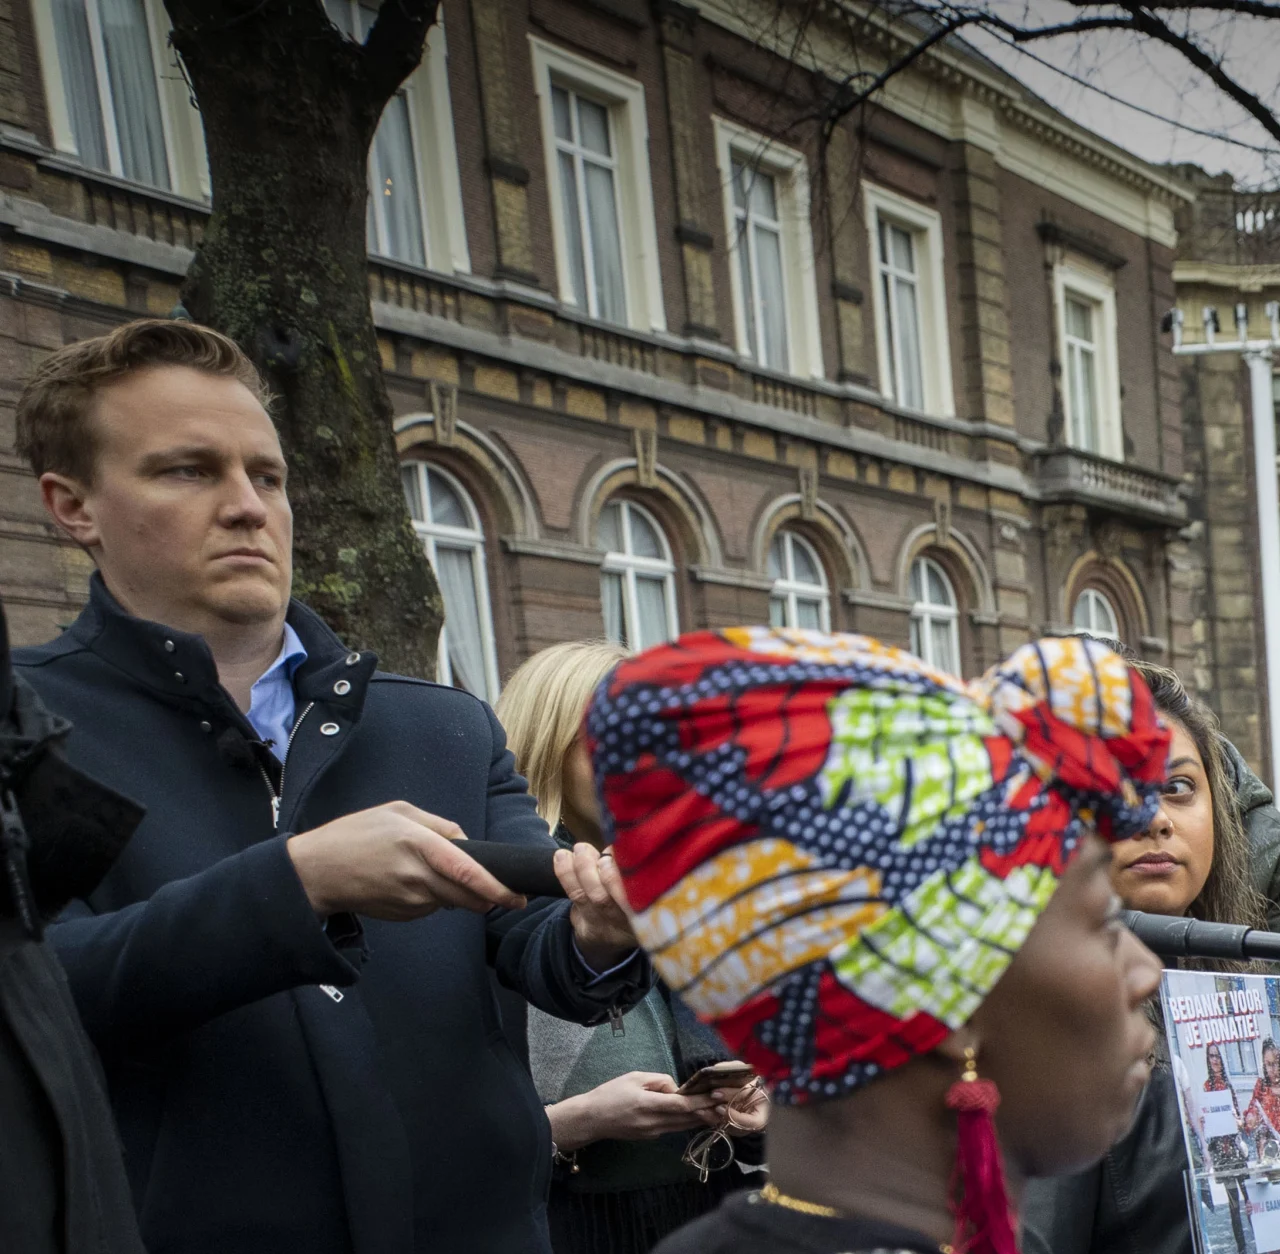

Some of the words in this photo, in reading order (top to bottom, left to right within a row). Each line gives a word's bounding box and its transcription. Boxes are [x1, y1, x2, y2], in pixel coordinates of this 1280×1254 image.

[1169, 991, 1229, 1024] BEDANKT
[1229, 988, 1264, 1016] VOOR
[1185, 1021, 1203, 1049] JE
[1203, 1014, 1261, 1046] DONATIE!
